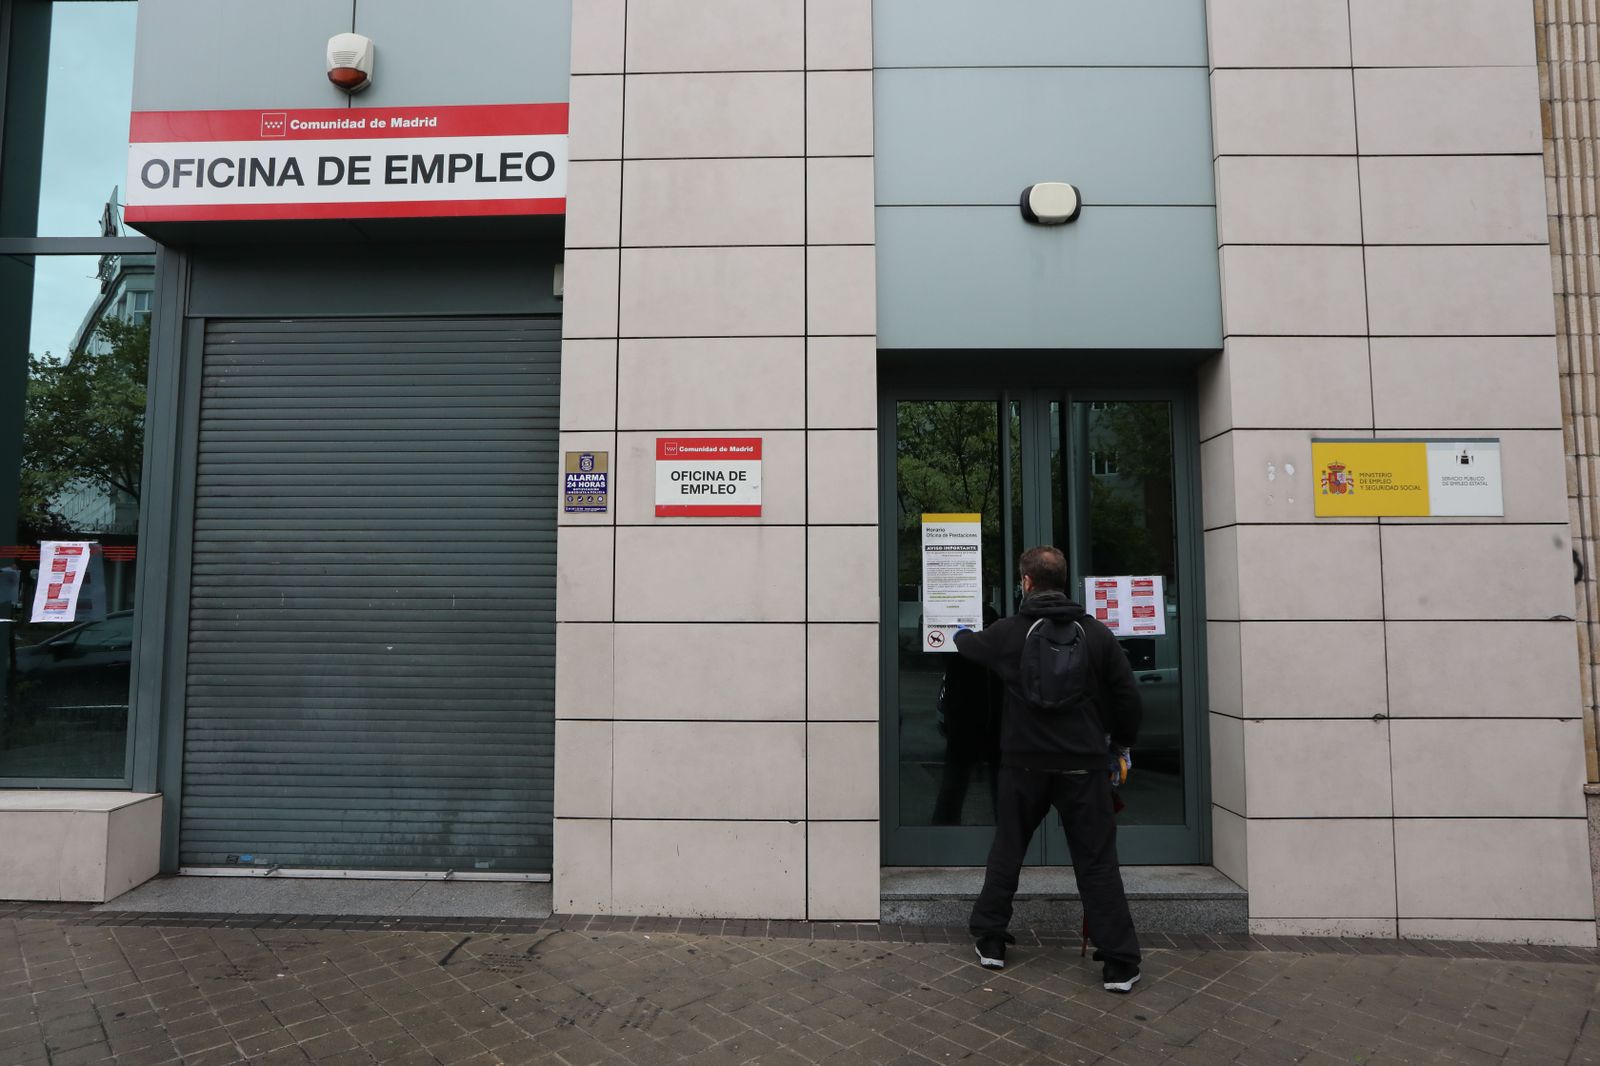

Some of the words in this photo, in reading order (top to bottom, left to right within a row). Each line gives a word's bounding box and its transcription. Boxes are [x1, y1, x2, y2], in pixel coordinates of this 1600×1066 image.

[290, 118, 365, 130] Comunidad
[369, 117, 386, 129] de
[390, 116, 437, 129] Madrid
[140, 156, 304, 189] OFICINA
[317, 155, 372, 186] DE
[384, 150, 556, 185] EMPLEO
[567, 474, 605, 482] ALARMA
[670, 470, 725, 481] OFICINA
[729, 470, 747, 481] DE
[681, 484, 736, 495] EMPLEO
